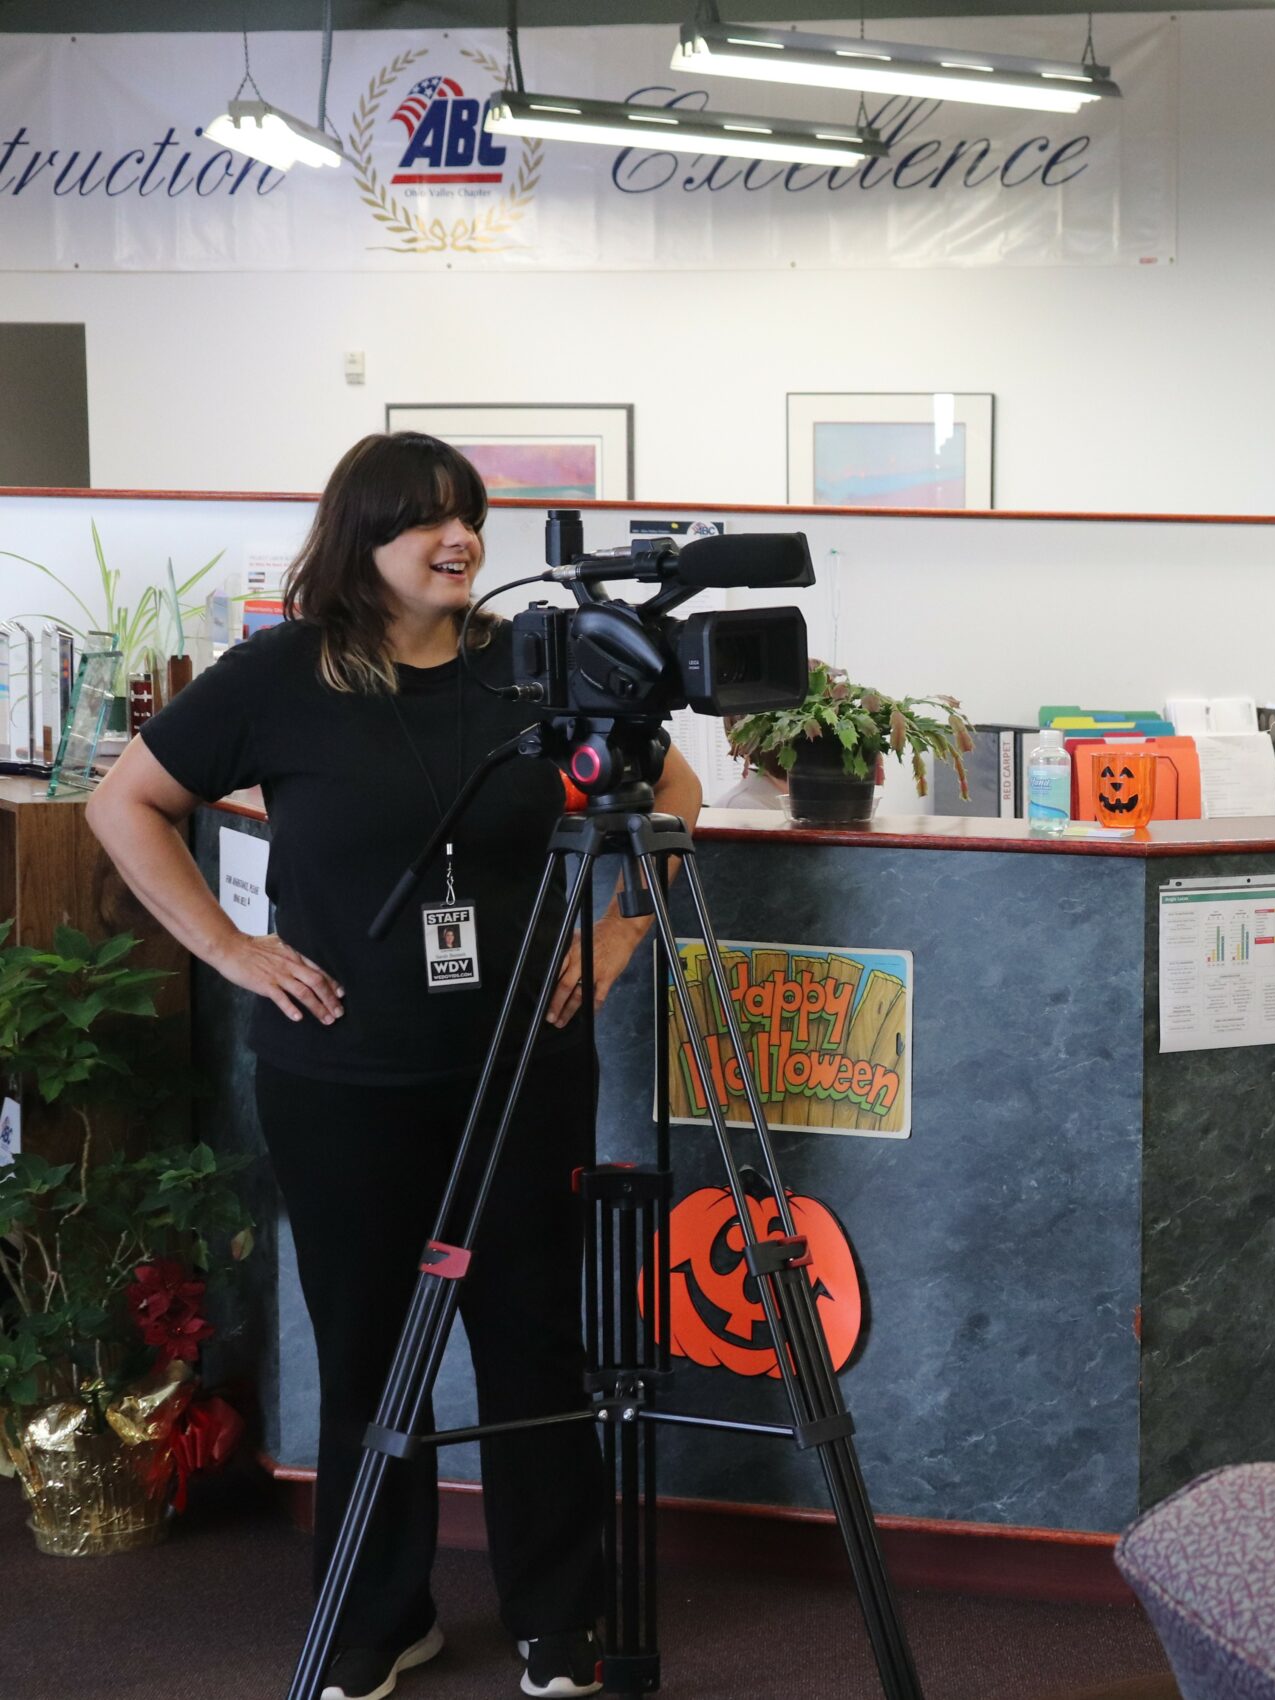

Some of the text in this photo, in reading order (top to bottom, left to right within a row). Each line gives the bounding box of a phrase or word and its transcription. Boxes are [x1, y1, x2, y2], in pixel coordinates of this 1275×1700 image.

[398, 98, 507, 167] ABC
[457, 187, 492, 199] Chapter
[1003, 742, 1012, 801] RED CARPET
[427, 911, 468, 924] STAFF
[433, 960, 469, 974] WDV
[709, 961, 855, 1049] Happy
[679, 1031, 900, 1116] Halloween
